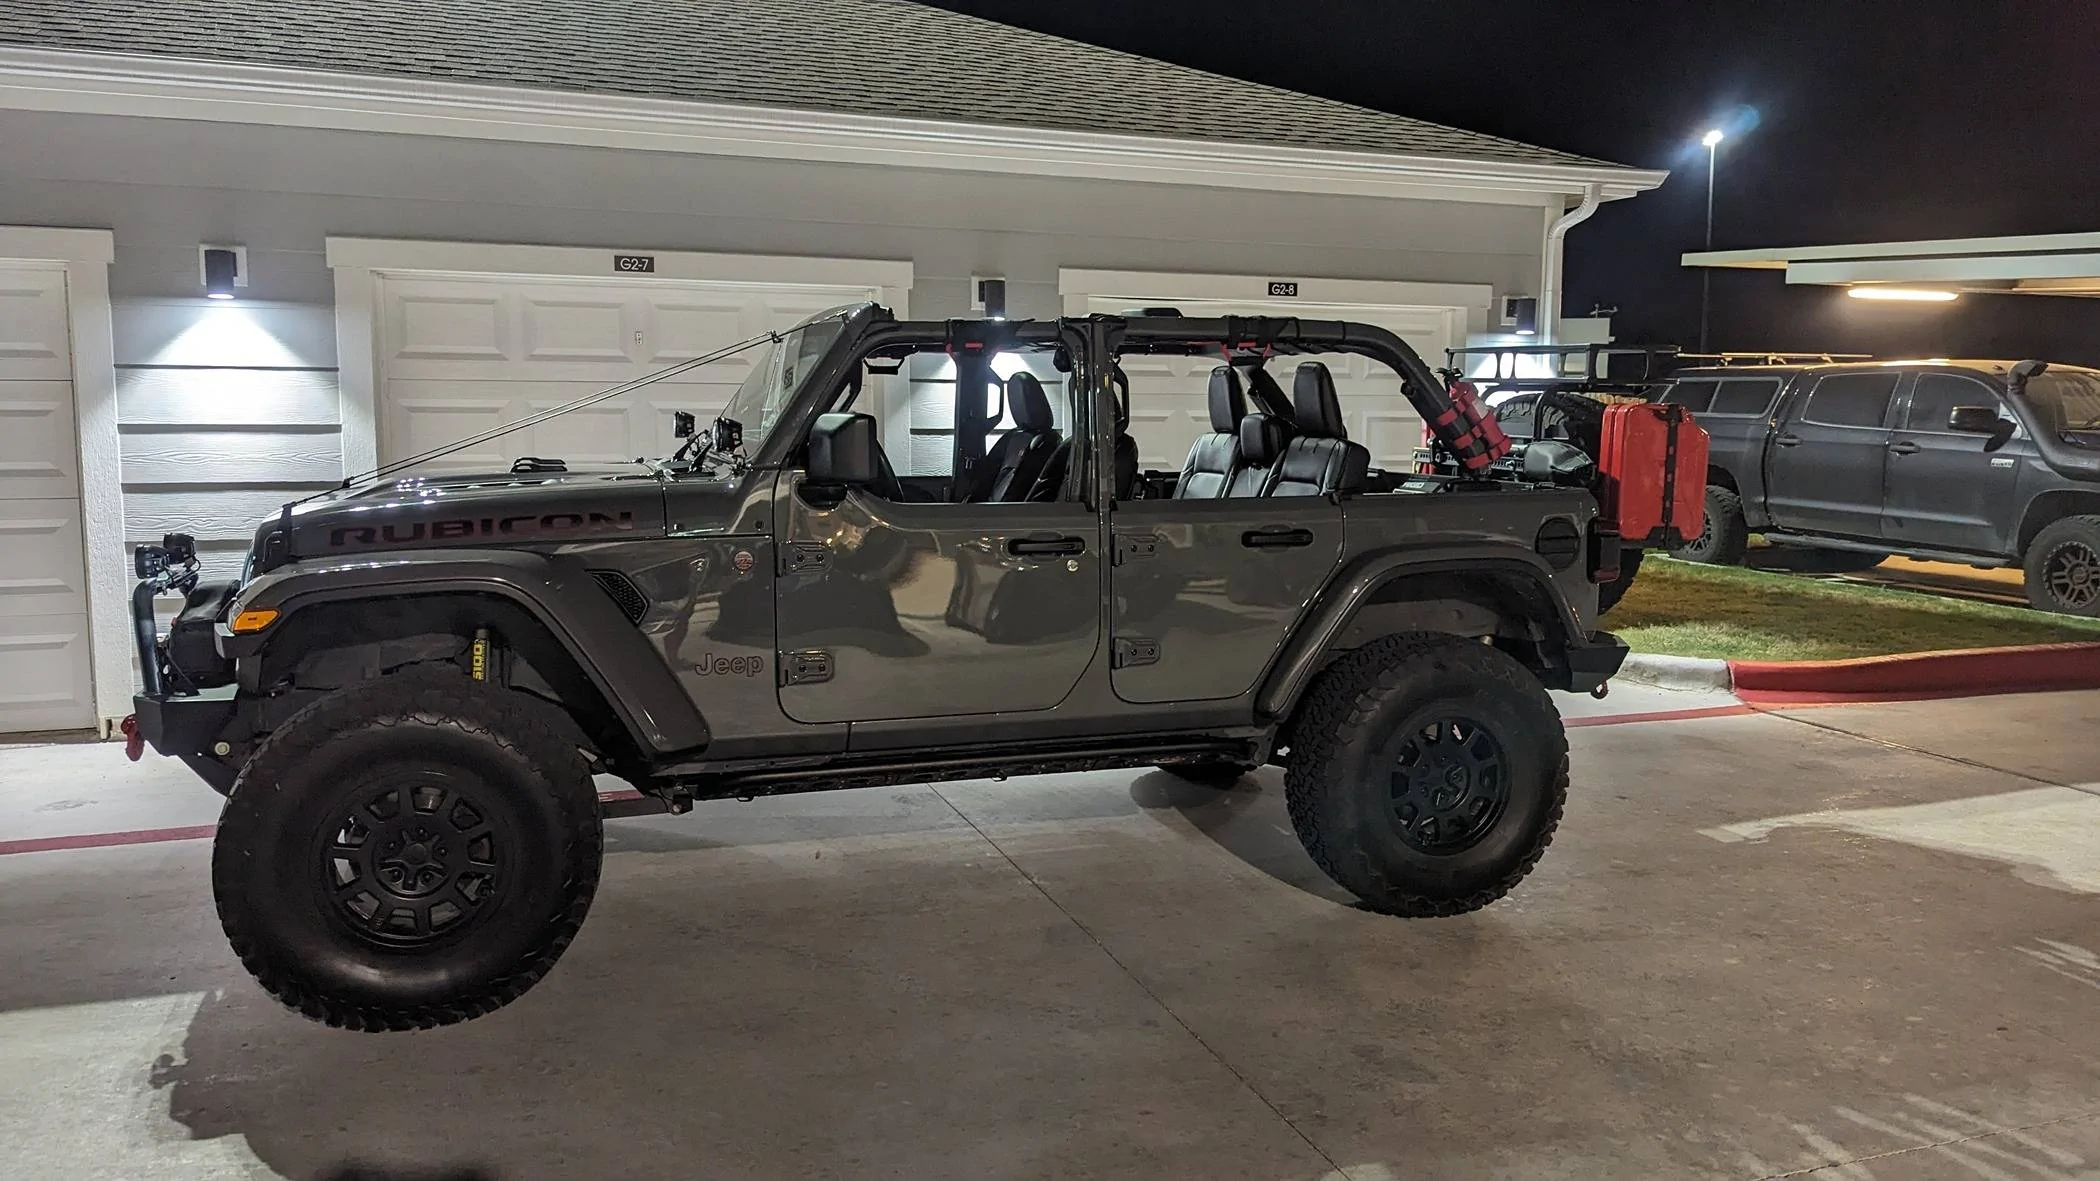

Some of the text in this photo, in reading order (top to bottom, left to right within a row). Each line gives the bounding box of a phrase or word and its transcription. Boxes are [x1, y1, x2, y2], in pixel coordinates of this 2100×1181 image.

[620, 257, 649, 271] G2-7
[1271, 283, 1295, 295] G2-8
[329, 511, 633, 547] RUBICON
[695, 652, 764, 678] Jeep
